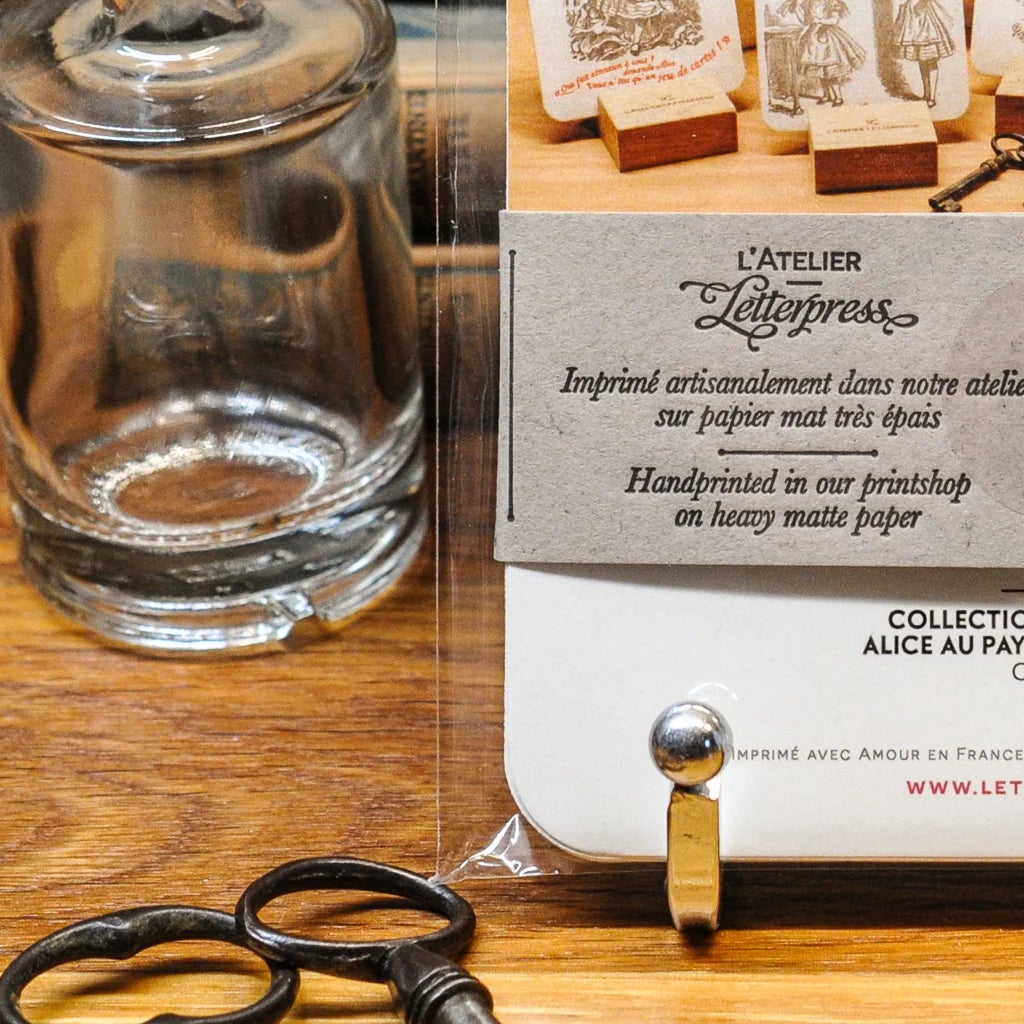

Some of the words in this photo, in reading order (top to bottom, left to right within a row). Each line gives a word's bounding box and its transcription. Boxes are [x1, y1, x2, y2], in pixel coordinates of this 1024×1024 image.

[680, 275, 919, 351] Letterpress
[560, 367, 660, 402] Imprimé
[665, 369, 832, 396] artisanalement
[839, 369, 892, 396] dans
[901, 374, 958, 396] notre
[655, 407, 693, 428] sur
[697, 403, 774, 435] papier
[780, 406, 826, 429] mat
[834, 406, 873, 429] très
[882, 402, 942, 435] épais
[624, 466, 776, 500] Handprinted
[784, 469, 807, 494] in
[815, 474, 855, 494] our
[860, 469, 971, 503] printshop
[675, 508, 703, 528] on
[710, 501, 775, 535] heavy
[784, 505, 847, 528] matte
[856, 506, 922, 536] paper
[863, 635, 932, 656] ALICE
[940, 635, 974, 655] AU
[808, 748, 851, 761] AVEC
[859, 747, 920, 761] AMOUR
[928, 748, 947, 761] EN
[957, 747, 1023, 761] FRANCE
